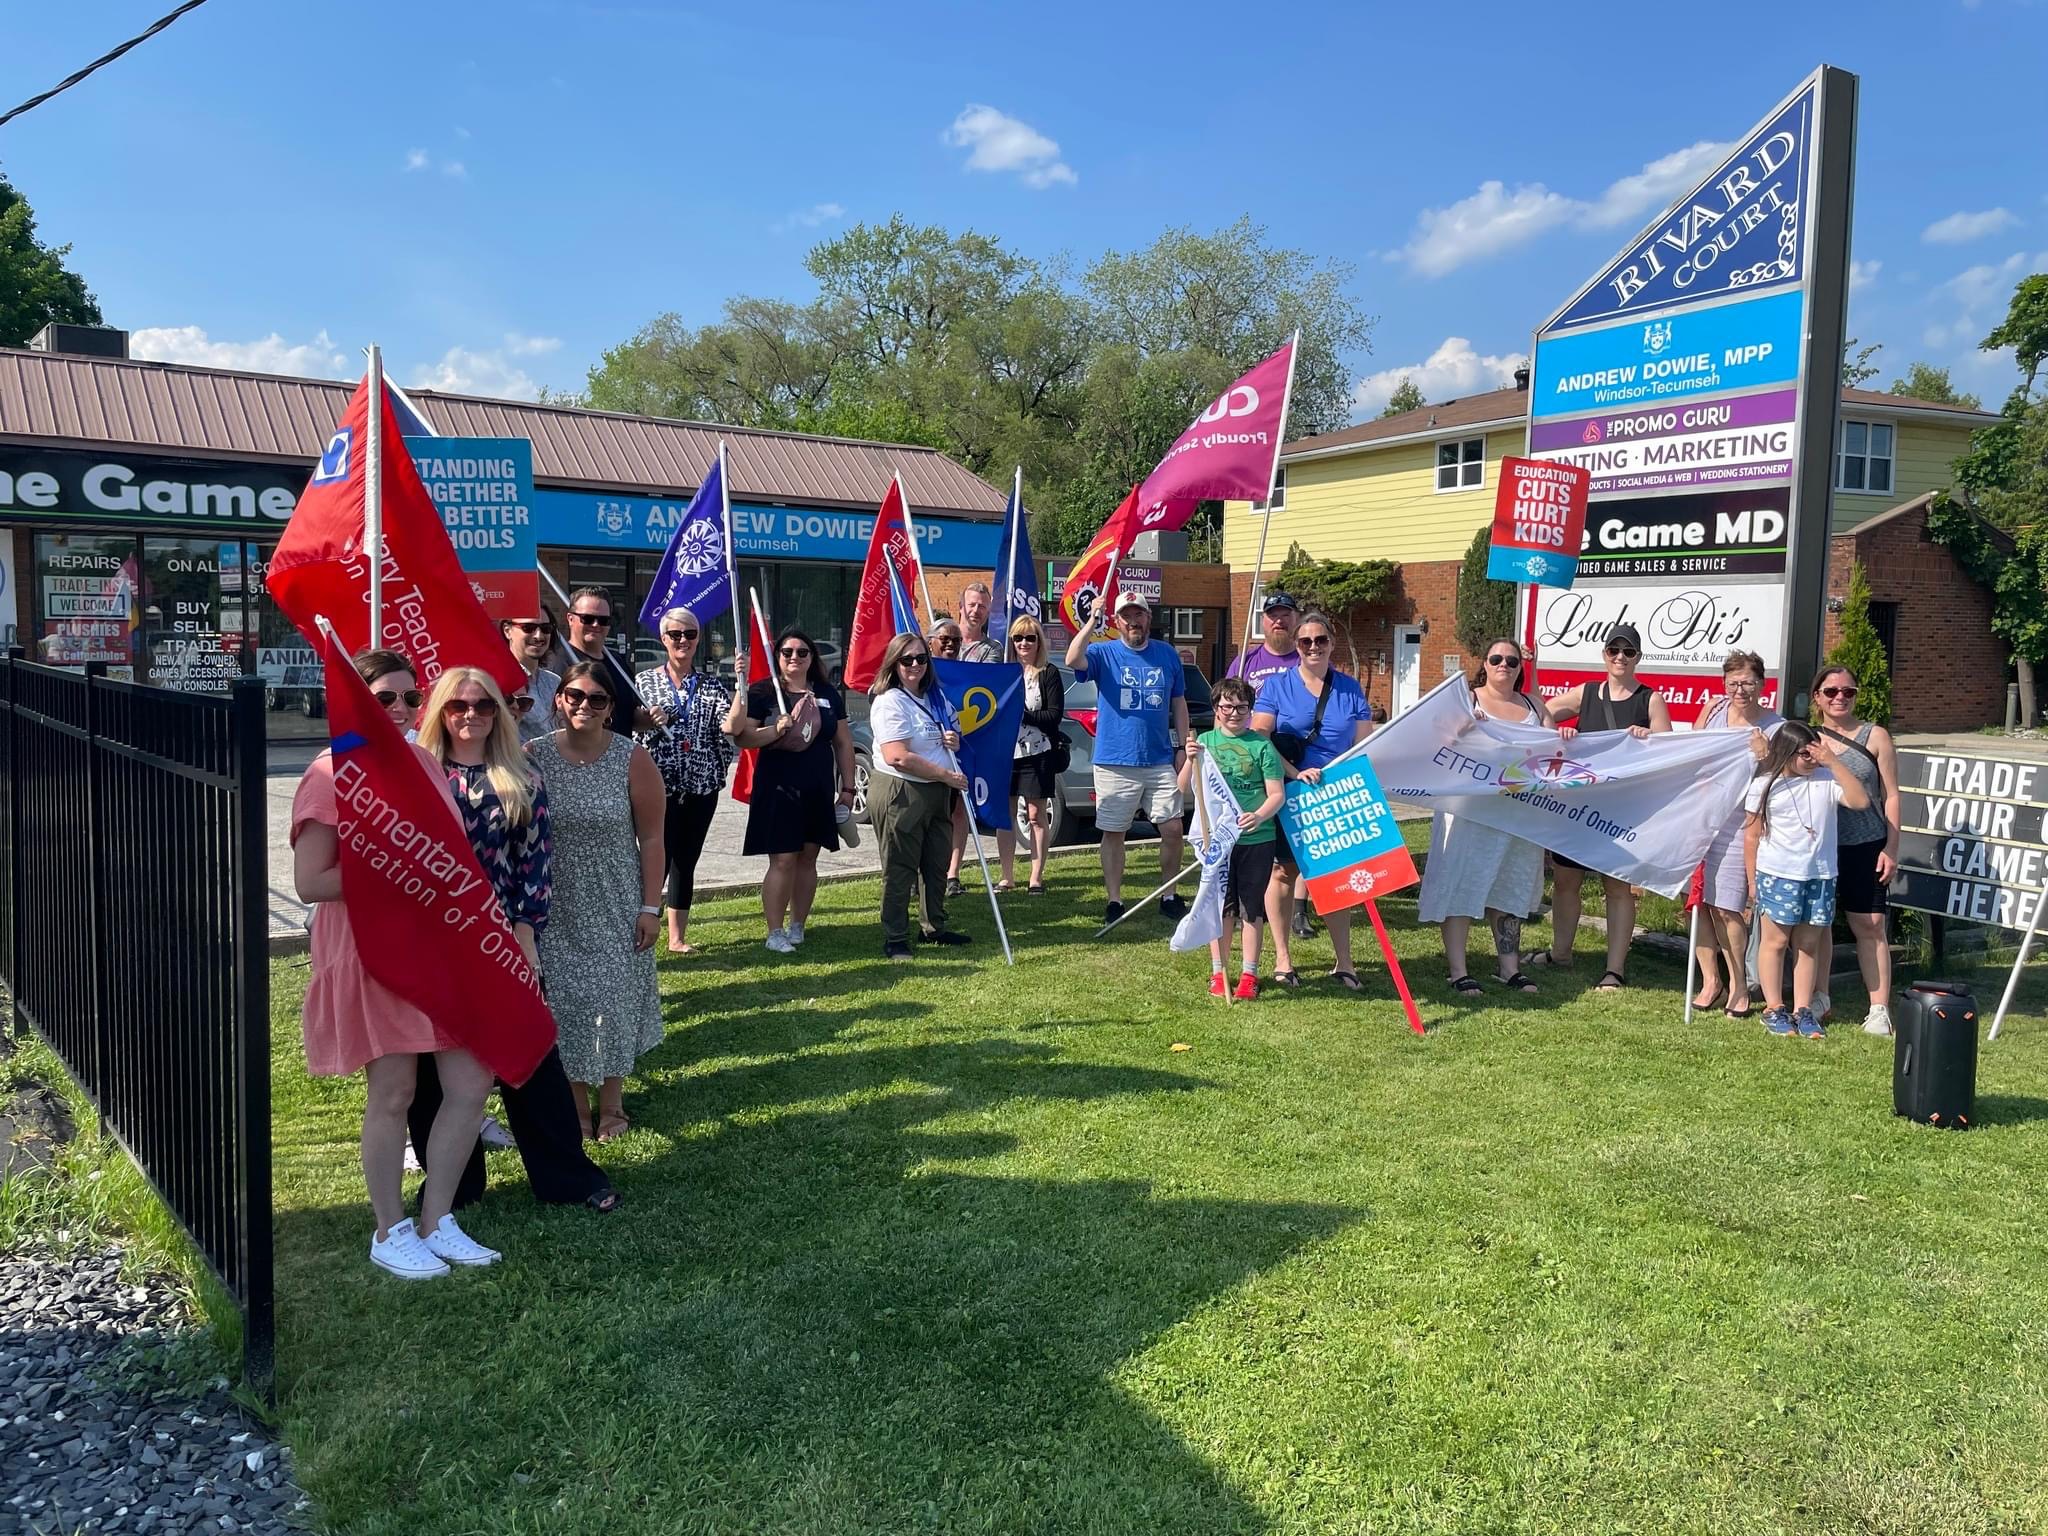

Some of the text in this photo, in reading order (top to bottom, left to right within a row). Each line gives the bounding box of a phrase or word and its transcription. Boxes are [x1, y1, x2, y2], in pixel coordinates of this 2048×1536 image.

[1609, 132, 1794, 307] RIVARD
[1672, 182, 1783, 289] COURT
[1556, 343, 1773, 394] ANDREW DOWIE, MPP
[1594, 372, 1720, 403] Windsor-Tecumseh
[1606, 405, 1731, 438] THE PROMO GURU
[1643, 431, 1787, 466] MARKETING
[413, 458, 516, 479] TANDING
[1514, 465, 1577, 485] EDUCATION
[1589, 464, 1789, 491] DUCTS SOCIAL MEDIA & WEB WEDDING STATIONERY
[82, 464, 296, 519] Game
[1517, 479, 1571, 504] CUTS
[445, 506, 529, 526] BETTER
[1513, 500, 1571, 526] HURT
[1514, 522, 1564, 547] KIDS
[1599, 519, 1705, 549] Game
[1714, 510, 1784, 544] MD
[49, 555, 121, 569] REPAIRS
[167, 559, 194, 572] ON
[196, 560, 227, 573] ALL
[1125, 568, 1150, 579] GURU
[1604, 561, 1630, 573] GAME
[1634, 560, 1665, 572] SALES
[1670, 559, 1677, 571] &
[1682, 557, 1727, 570] SERVICE
[53, 578, 119, 592] TRADE-INS
[60, 599, 115, 612] WELCOME
[176, 602, 211, 614] BUY
[57, 623, 120, 638] PLUSHIES
[173, 621, 214, 633] SELL
[1538, 592, 1636, 648] Lad
[164, 639, 222, 653] TRADE
[1641, 651, 1726, 664] ressmaking & Alter
[155, 655, 174, 666] NEW
[185, 655, 235, 666] PRE-OWNED
[184, 667, 242, 679] ACCESSORIES
[185, 680, 229, 691] CONSOLES
[1432, 746, 1492, 781] ETFO
[1926, 756, 2037, 801] TRADE
[1287, 773, 1366, 812] STANDING
[1291, 789, 1373, 828] TOGETHER
[1925, 796, 2015, 840] YOUR
[333, 760, 482, 897] Elementary
[1291, 801, 1387, 848] FOR BETTER
[1568, 804, 1588, 822] of
[1586, 811, 1637, 842] Ontario
[1308, 822, 1382, 860] SCHOOLS
[1946, 880, 2039, 928] HERE
[443, 908, 478, 932] of
